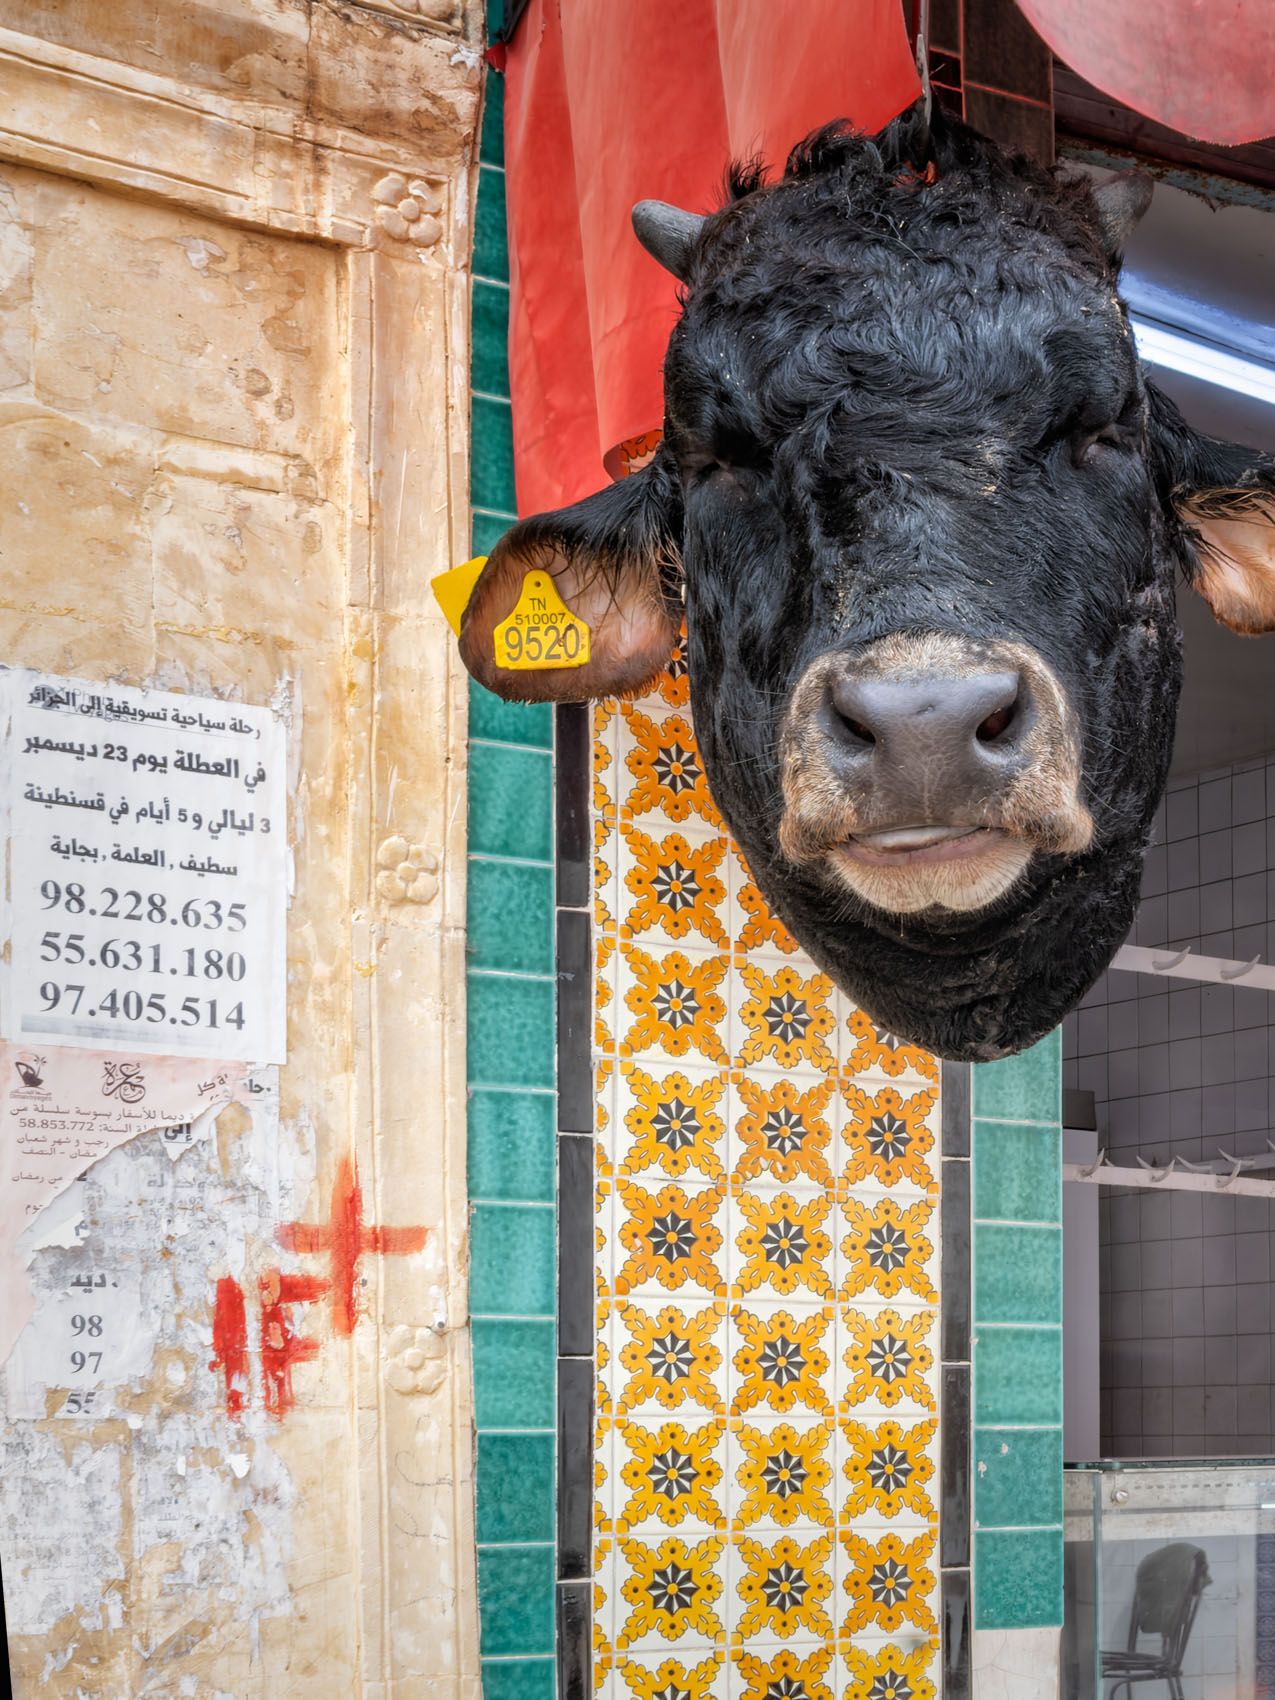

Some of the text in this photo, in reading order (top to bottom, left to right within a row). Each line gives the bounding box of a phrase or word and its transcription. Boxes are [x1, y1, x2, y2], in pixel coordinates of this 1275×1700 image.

[529, 598, 547, 611] TN
[515, 613, 566, 626] 510007
[504, 624, 581, 662] 9520
[105, 697, 167, 722] تسويقية
[171, 707, 226, 731] سياحية
[229, 718, 261, 740] رحلة
[22, 736, 266, 793] في العطلة يوم 23 ديسمبر
[23, 783, 105, 811] قسنطينة
[135, 797, 170, 823] أيام
[109, 796, 129, 825] في
[208, 808, 254, 840] ليالي
[260, 818, 271, 834] 3
[50, 835, 98, 863] بجاية
[40, 879, 247, 932] 98.228.635
[40, 931, 247, 982] 55.631.180
[40, 981, 246, 1031] 97.405.514
[19, 1117, 95, 1132] 58.853.772
[71, 1314, 103, 1338] 98
[70, 1351, 103, 1374] 97
